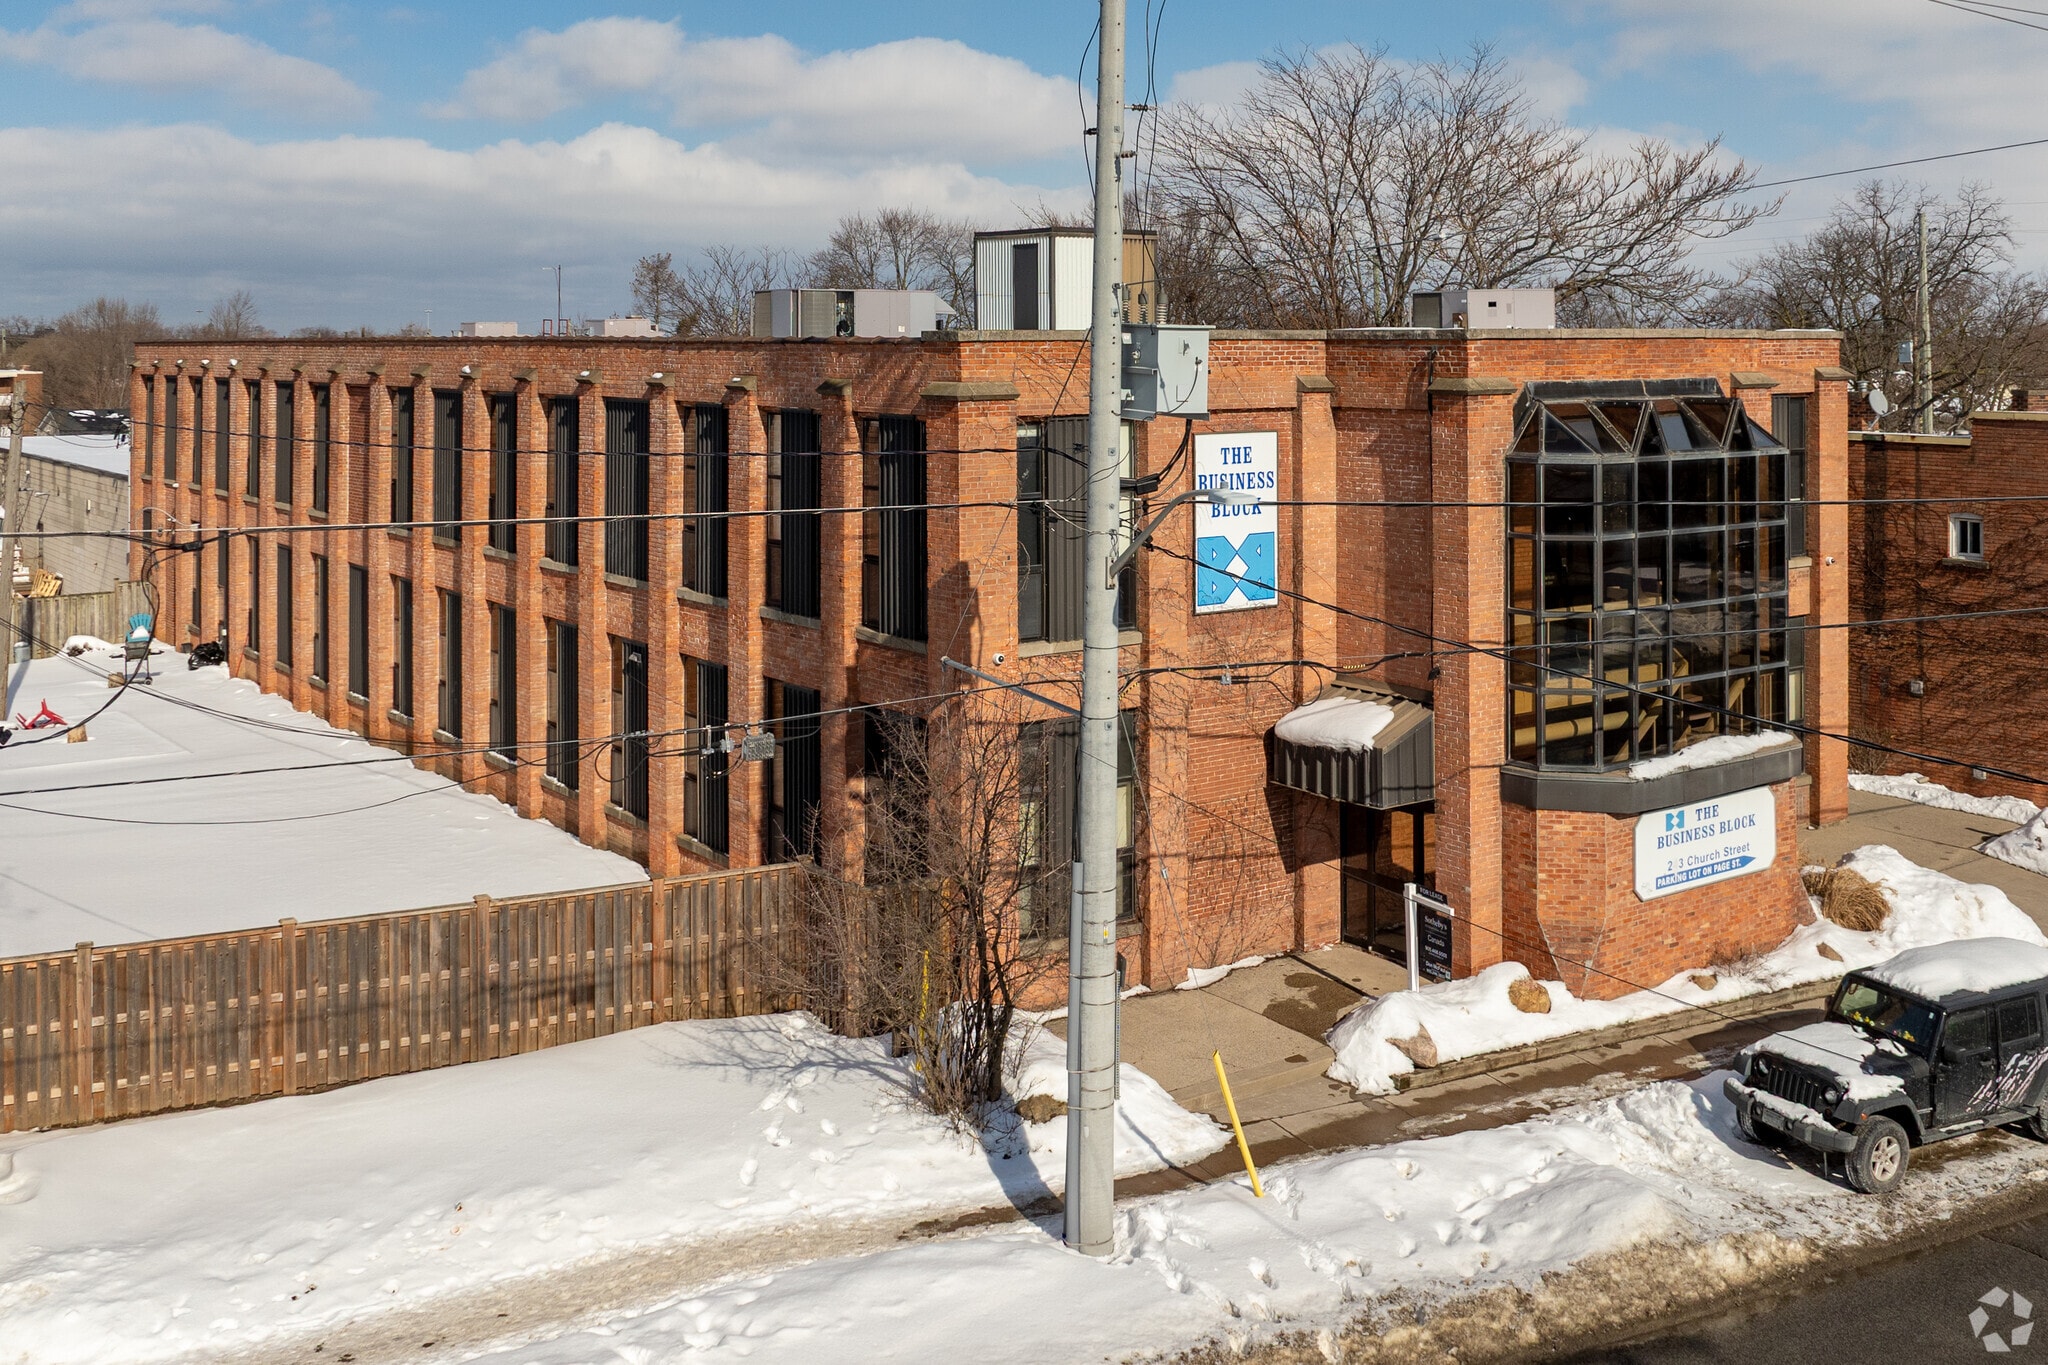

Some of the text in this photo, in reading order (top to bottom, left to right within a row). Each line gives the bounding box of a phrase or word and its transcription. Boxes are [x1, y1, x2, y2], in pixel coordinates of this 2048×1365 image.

[1220, 446, 1252, 465] THE
[1211, 497, 1262, 518] BLOCK
[1695, 804, 1719, 822] THE
[1657, 813, 1756, 849] BUSINESS BLOCK
[1687, 849, 1720, 866] Church
[1723, 842, 1750, 857] Street
[1657, 872, 1687, 887] PARKING
[1688, 869, 1701, 879] LOT
[1702, 866, 1712, 876] ON
[1713, 862, 1730, 873] PAGE
